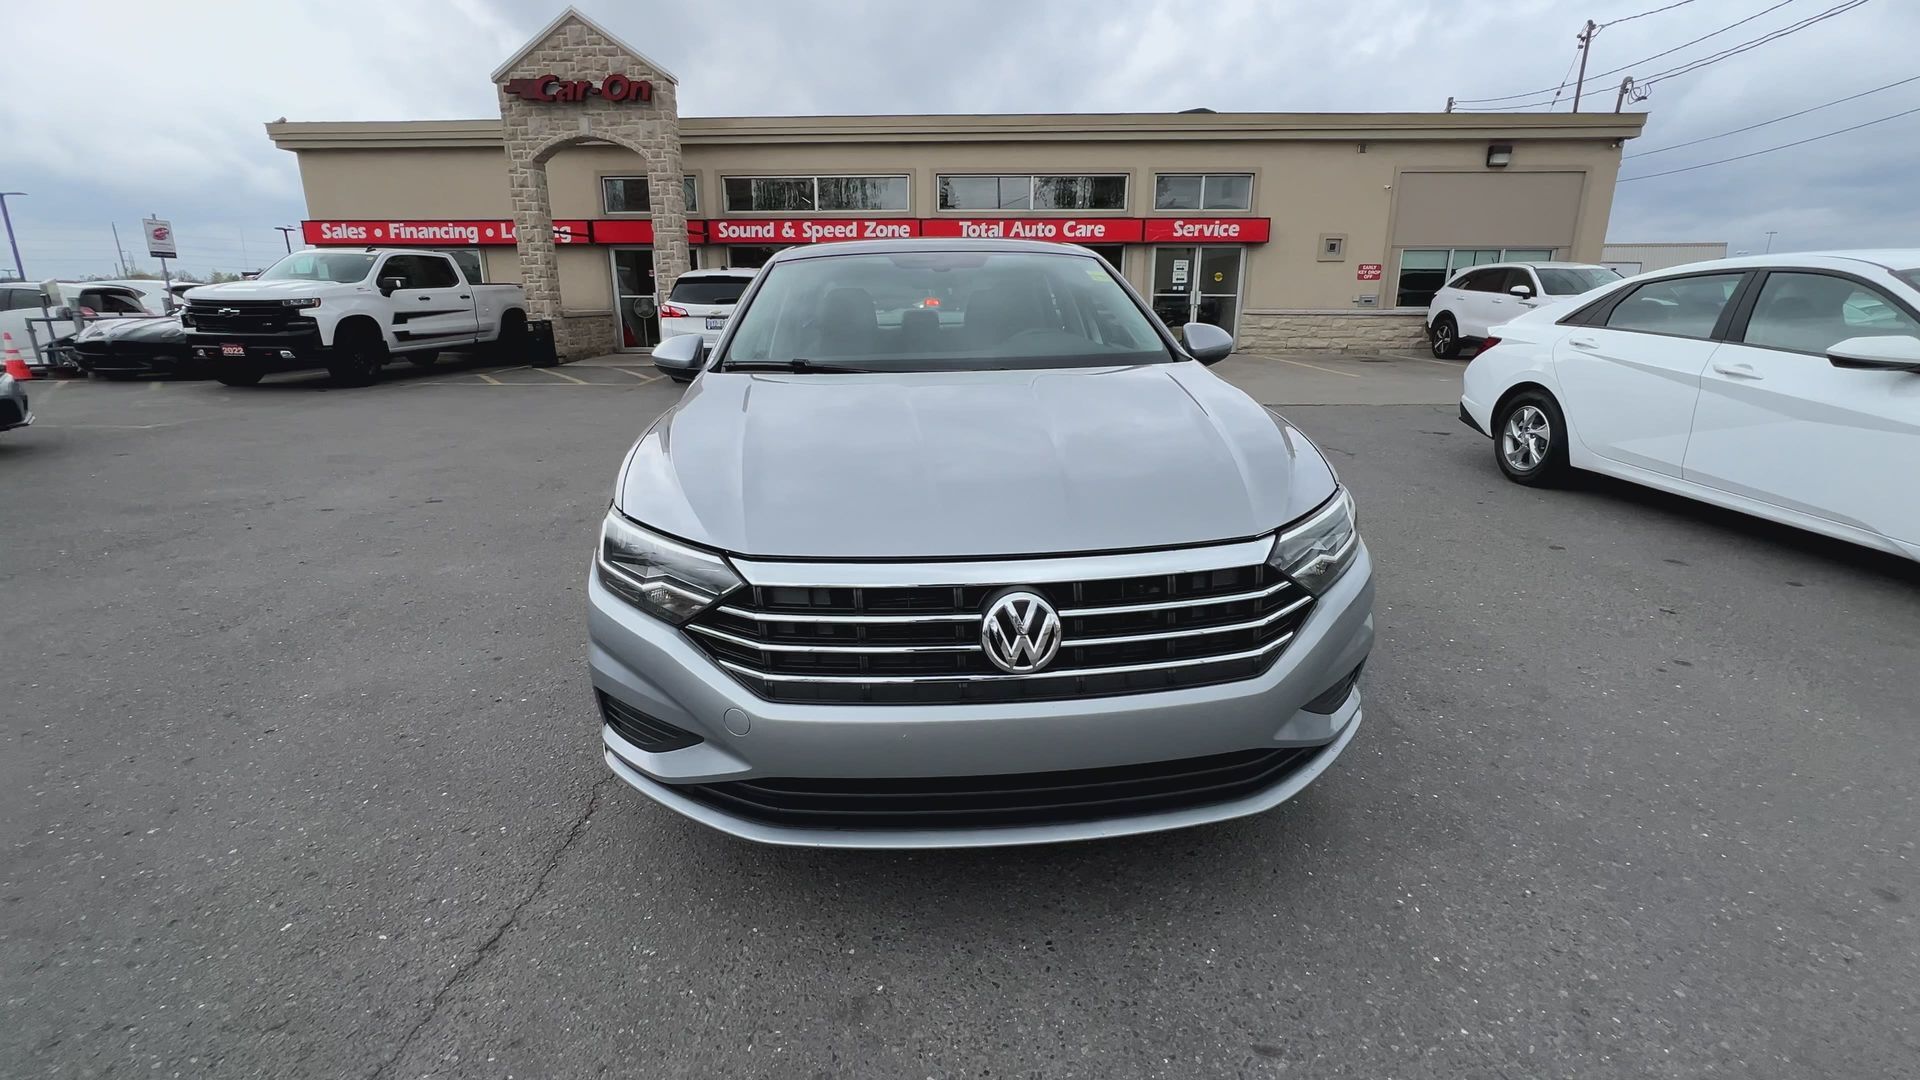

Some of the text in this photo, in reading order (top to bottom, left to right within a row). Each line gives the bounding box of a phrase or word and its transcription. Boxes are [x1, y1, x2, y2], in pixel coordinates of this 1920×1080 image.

[533, 74, 652, 101] Car-On
[320, 222, 367, 239] Sales
[388, 223, 479, 243] Financing
[718, 221, 911, 243] Sound & Speed Zone
[959, 221, 1105, 238] Total Auto Care
[1173, 220, 1240, 237] Service
